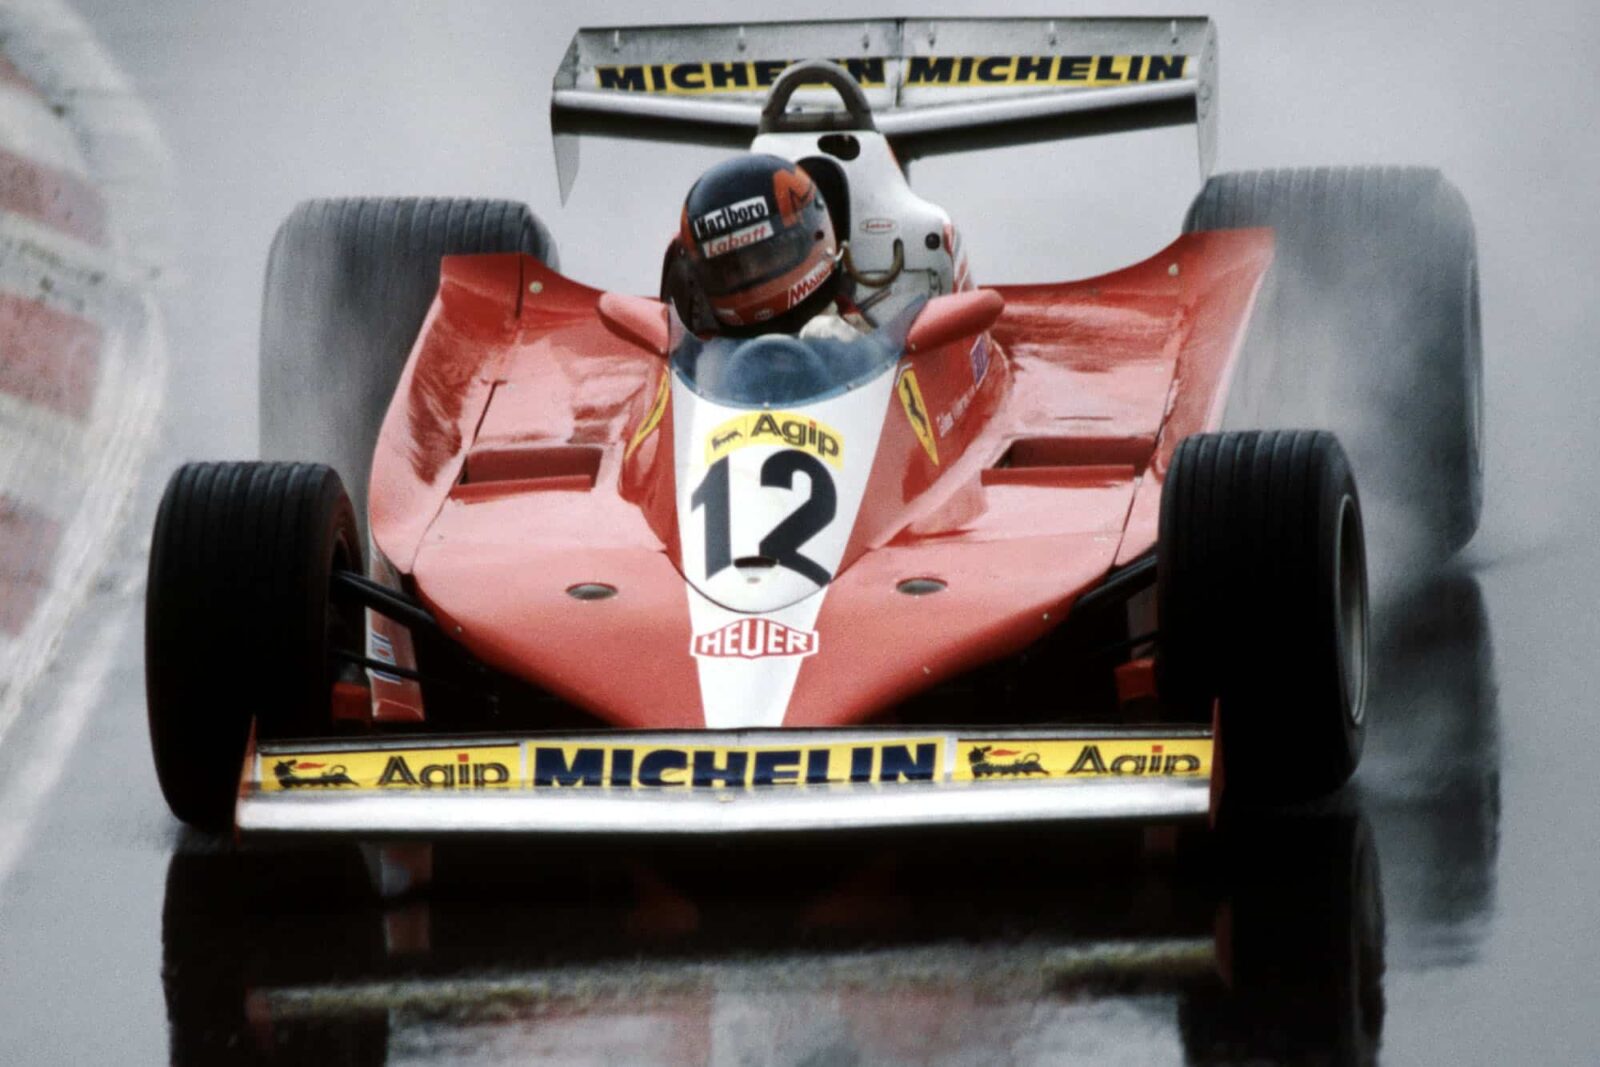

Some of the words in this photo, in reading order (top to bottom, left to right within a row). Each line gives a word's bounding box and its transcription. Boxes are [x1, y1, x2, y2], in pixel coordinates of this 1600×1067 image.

[597, 57, 884, 91] MICHEN
[909, 56, 1186, 83] MICHELIN
[708, 224, 768, 256] Labatt
[751, 413, 840, 458] Agip
[691, 449, 837, 588] 12
[701, 619, 809, 656] HEUER
[377, 753, 510, 787] Agip
[534, 743, 937, 787] MICHELIN
[1067, 745, 1201, 776] Agip
